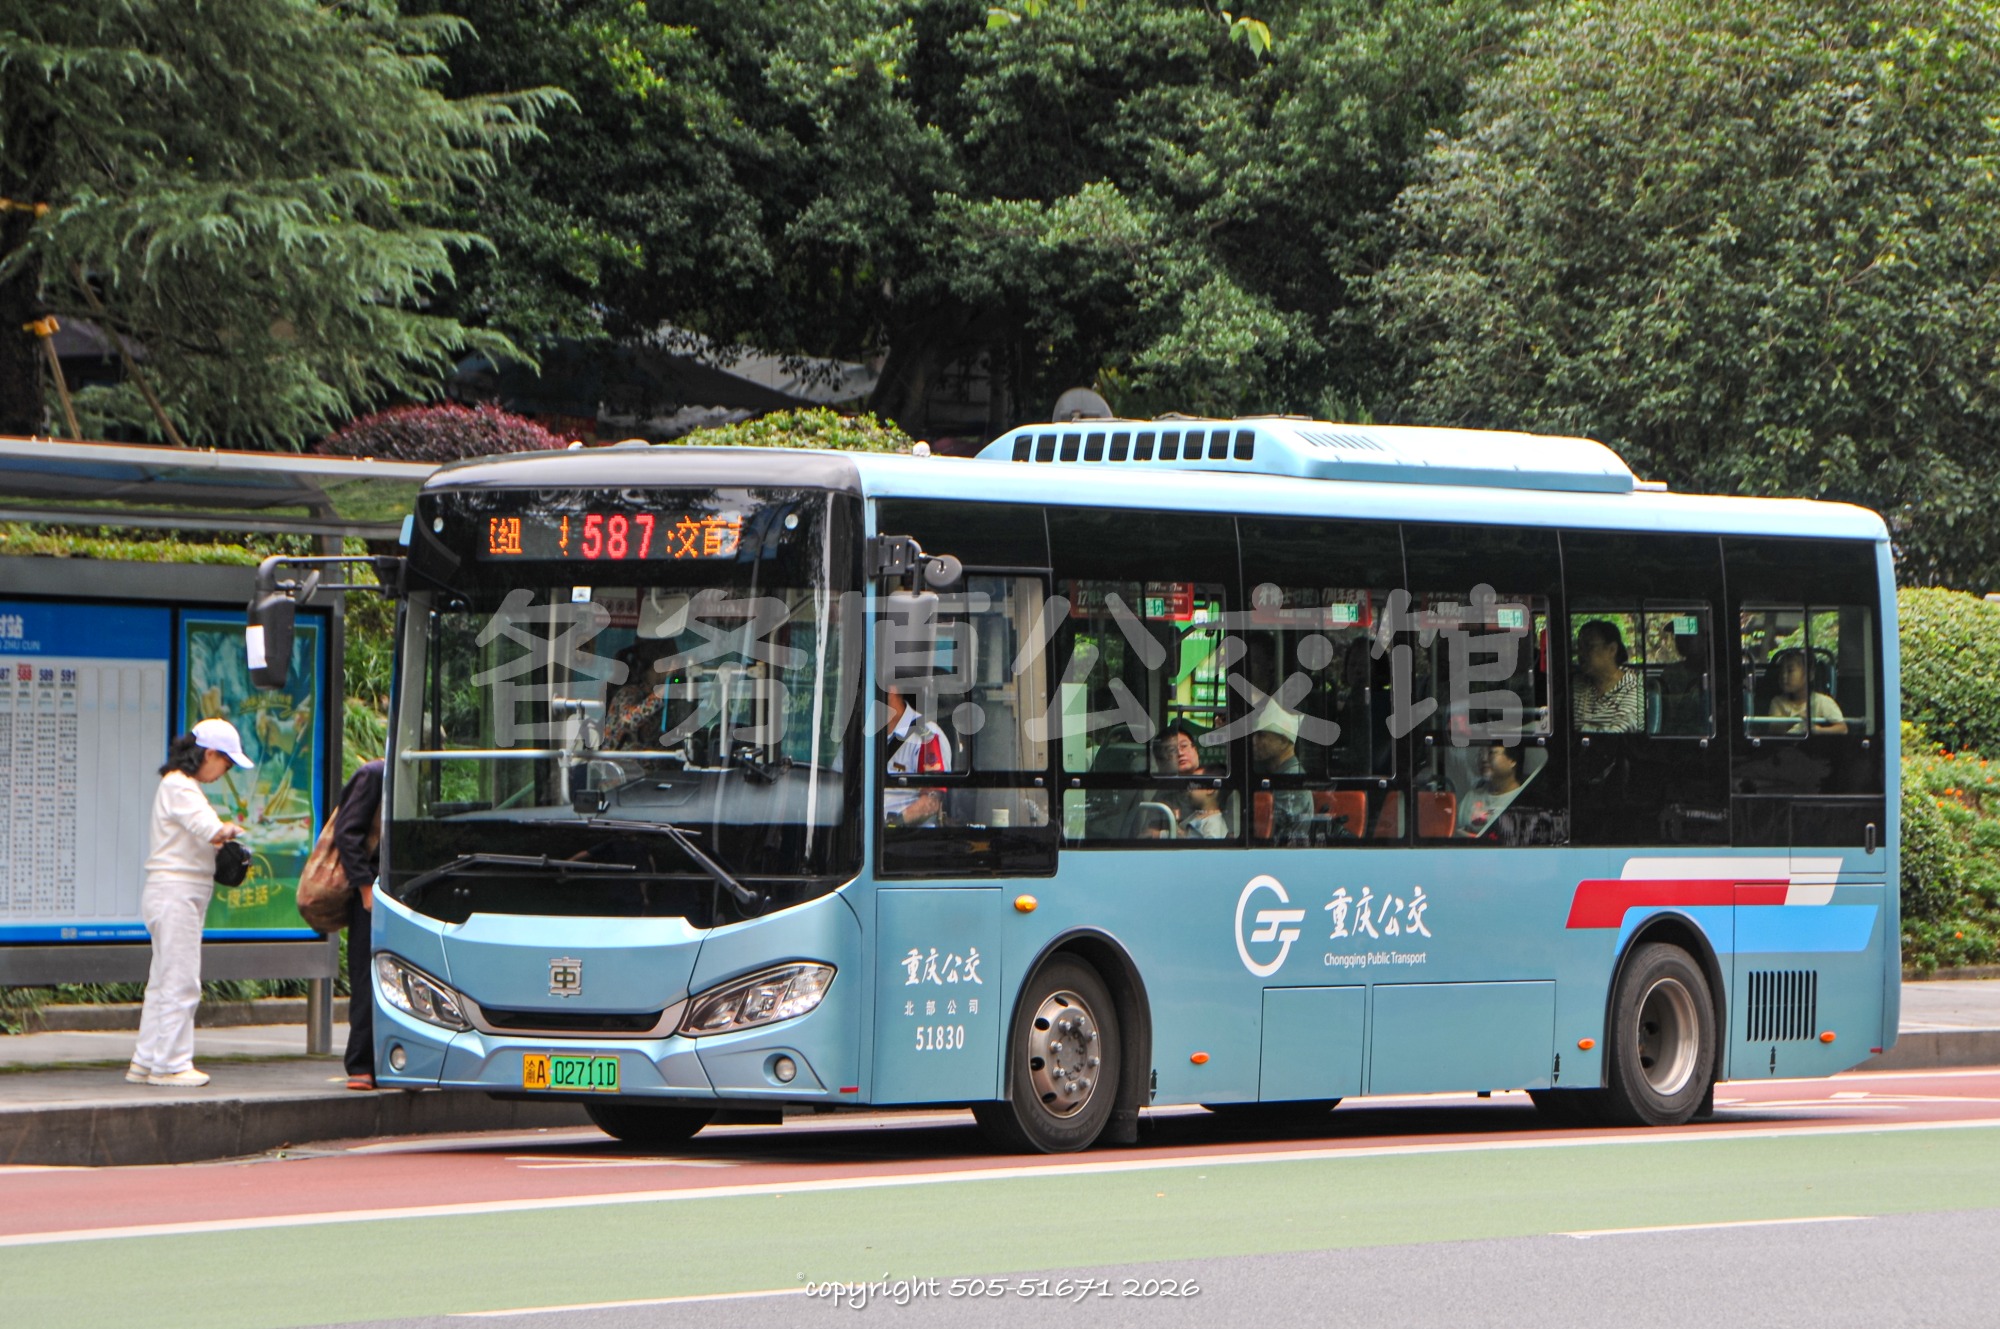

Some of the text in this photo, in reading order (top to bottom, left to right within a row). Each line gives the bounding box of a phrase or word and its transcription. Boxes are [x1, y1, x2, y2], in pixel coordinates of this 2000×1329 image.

[582, 513, 655, 560] 587
[61, 669, 76, 682] 591
[1324, 886, 1432, 940] 重庆公交
[901, 947, 983, 986] 重庆公交
[1324, 951, 1426, 968] Chongqing Public Transport
[904, 999, 979, 1016] 北部公司
[916, 1025, 965, 1051] 51830
[555, 1061, 616, 1086] 02711D
